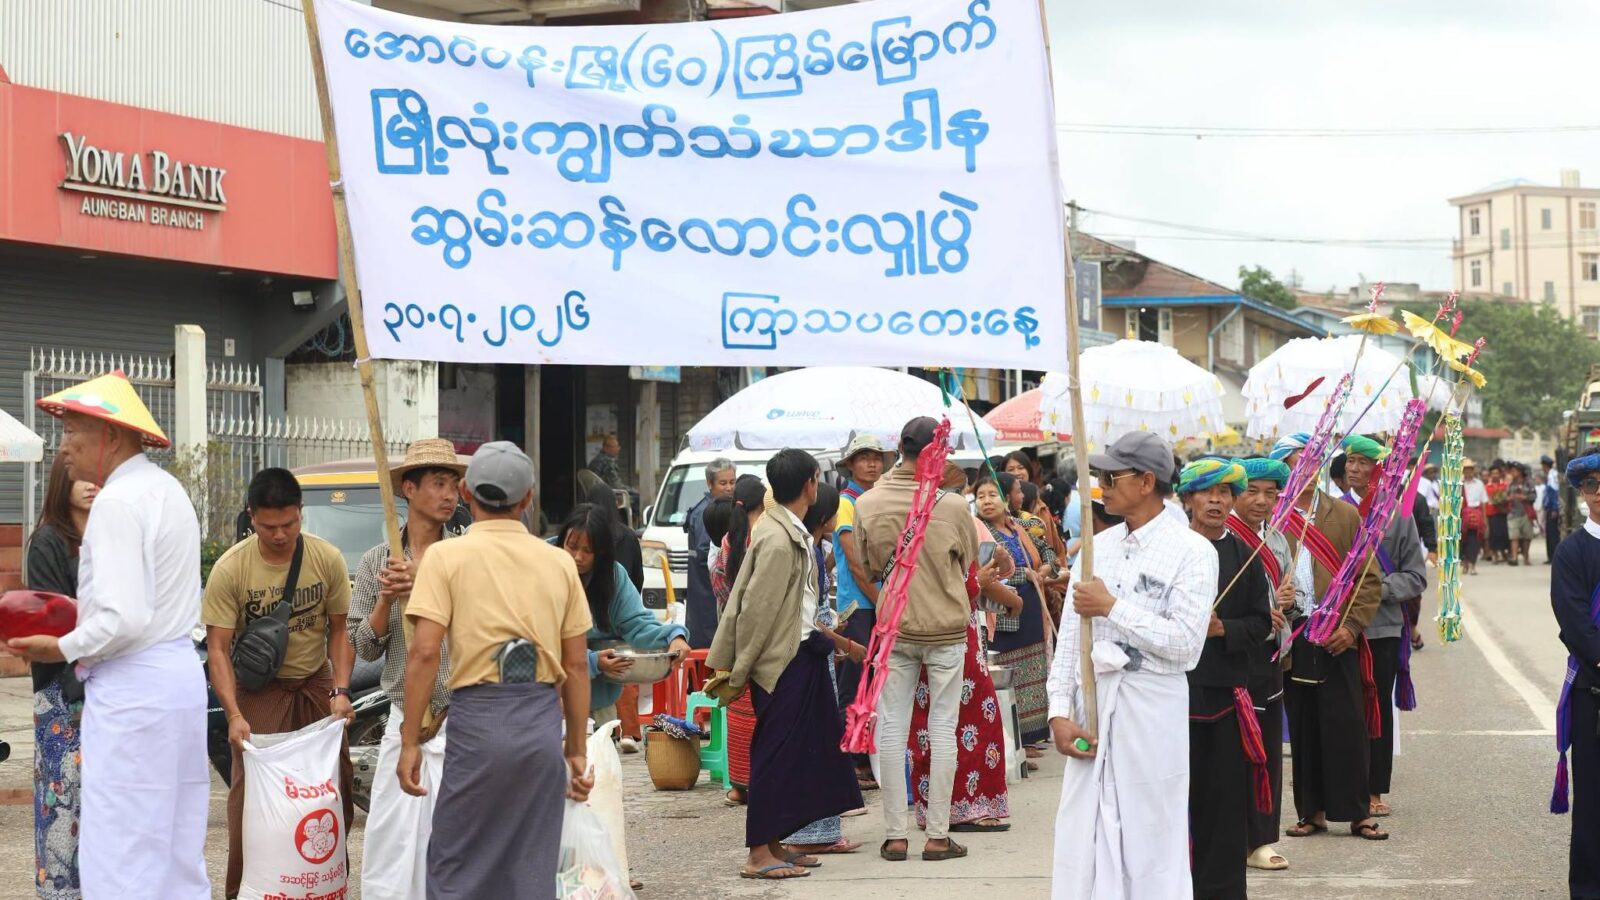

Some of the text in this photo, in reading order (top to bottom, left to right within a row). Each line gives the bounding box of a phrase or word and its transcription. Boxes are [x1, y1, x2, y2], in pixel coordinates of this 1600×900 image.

[62, 132, 227, 204] YOMA BANK
[81, 197, 204, 230] AUNGBAN BRANCH
[721, 291, 1041, 351] ကြာသပတေးနေ့
[247, 585, 286, 600] NEW YOR
